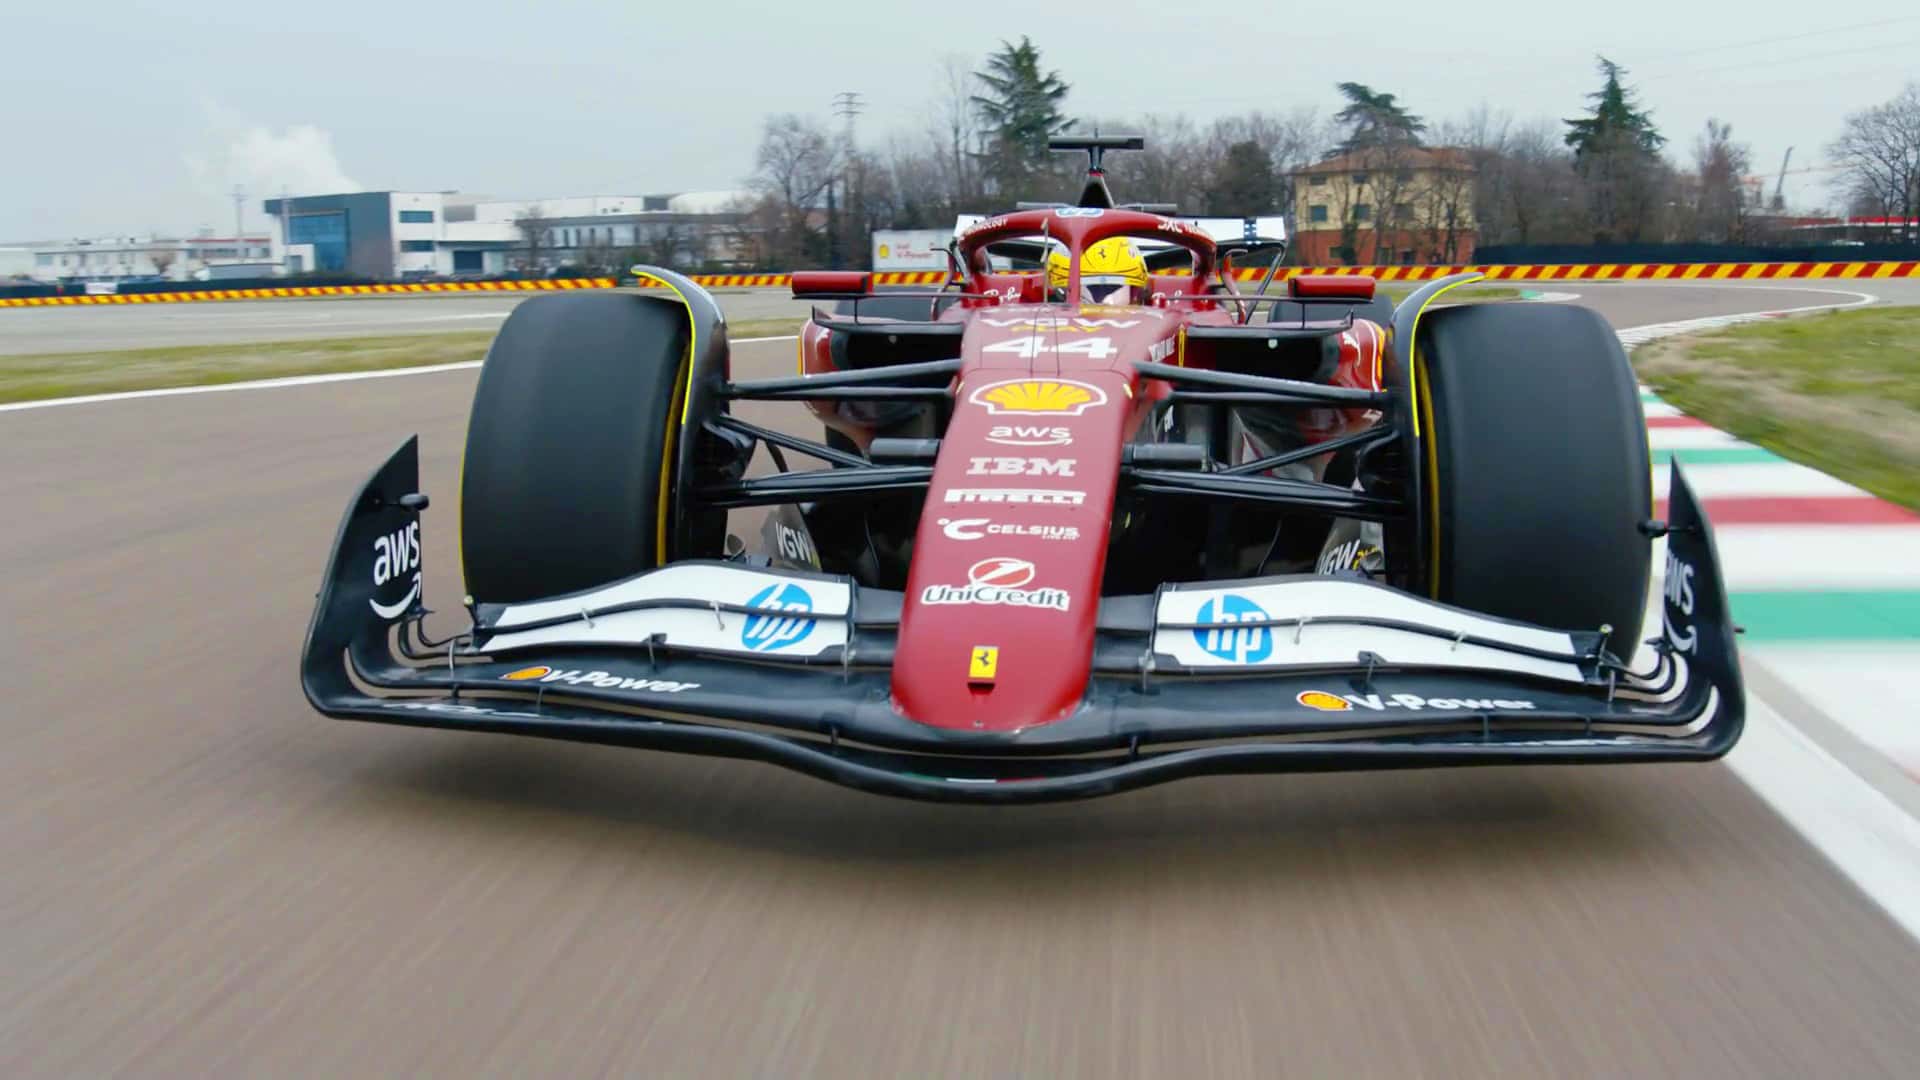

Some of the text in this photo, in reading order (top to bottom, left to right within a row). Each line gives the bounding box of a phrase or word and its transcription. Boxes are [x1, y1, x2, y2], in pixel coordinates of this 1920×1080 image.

[979, 317, 1142, 328] VGW
[982, 335, 1118, 359] 44
[988, 425, 1072, 439] aws
[966, 457, 1077, 477] IBM
[943, 488, 1088, 505] PIRELLI
[986, 524, 1079, 537] CELSIUS
[373, 520, 420, 587] aws
[775, 521, 812, 565] VGW
[920, 584, 1071, 612] UniCredit
[743, 583, 815, 652] hp
[1203, 592, 1268, 665] hp
[541, 669, 701, 693] V-Power
[1344, 693, 1536, 711] V-Power
